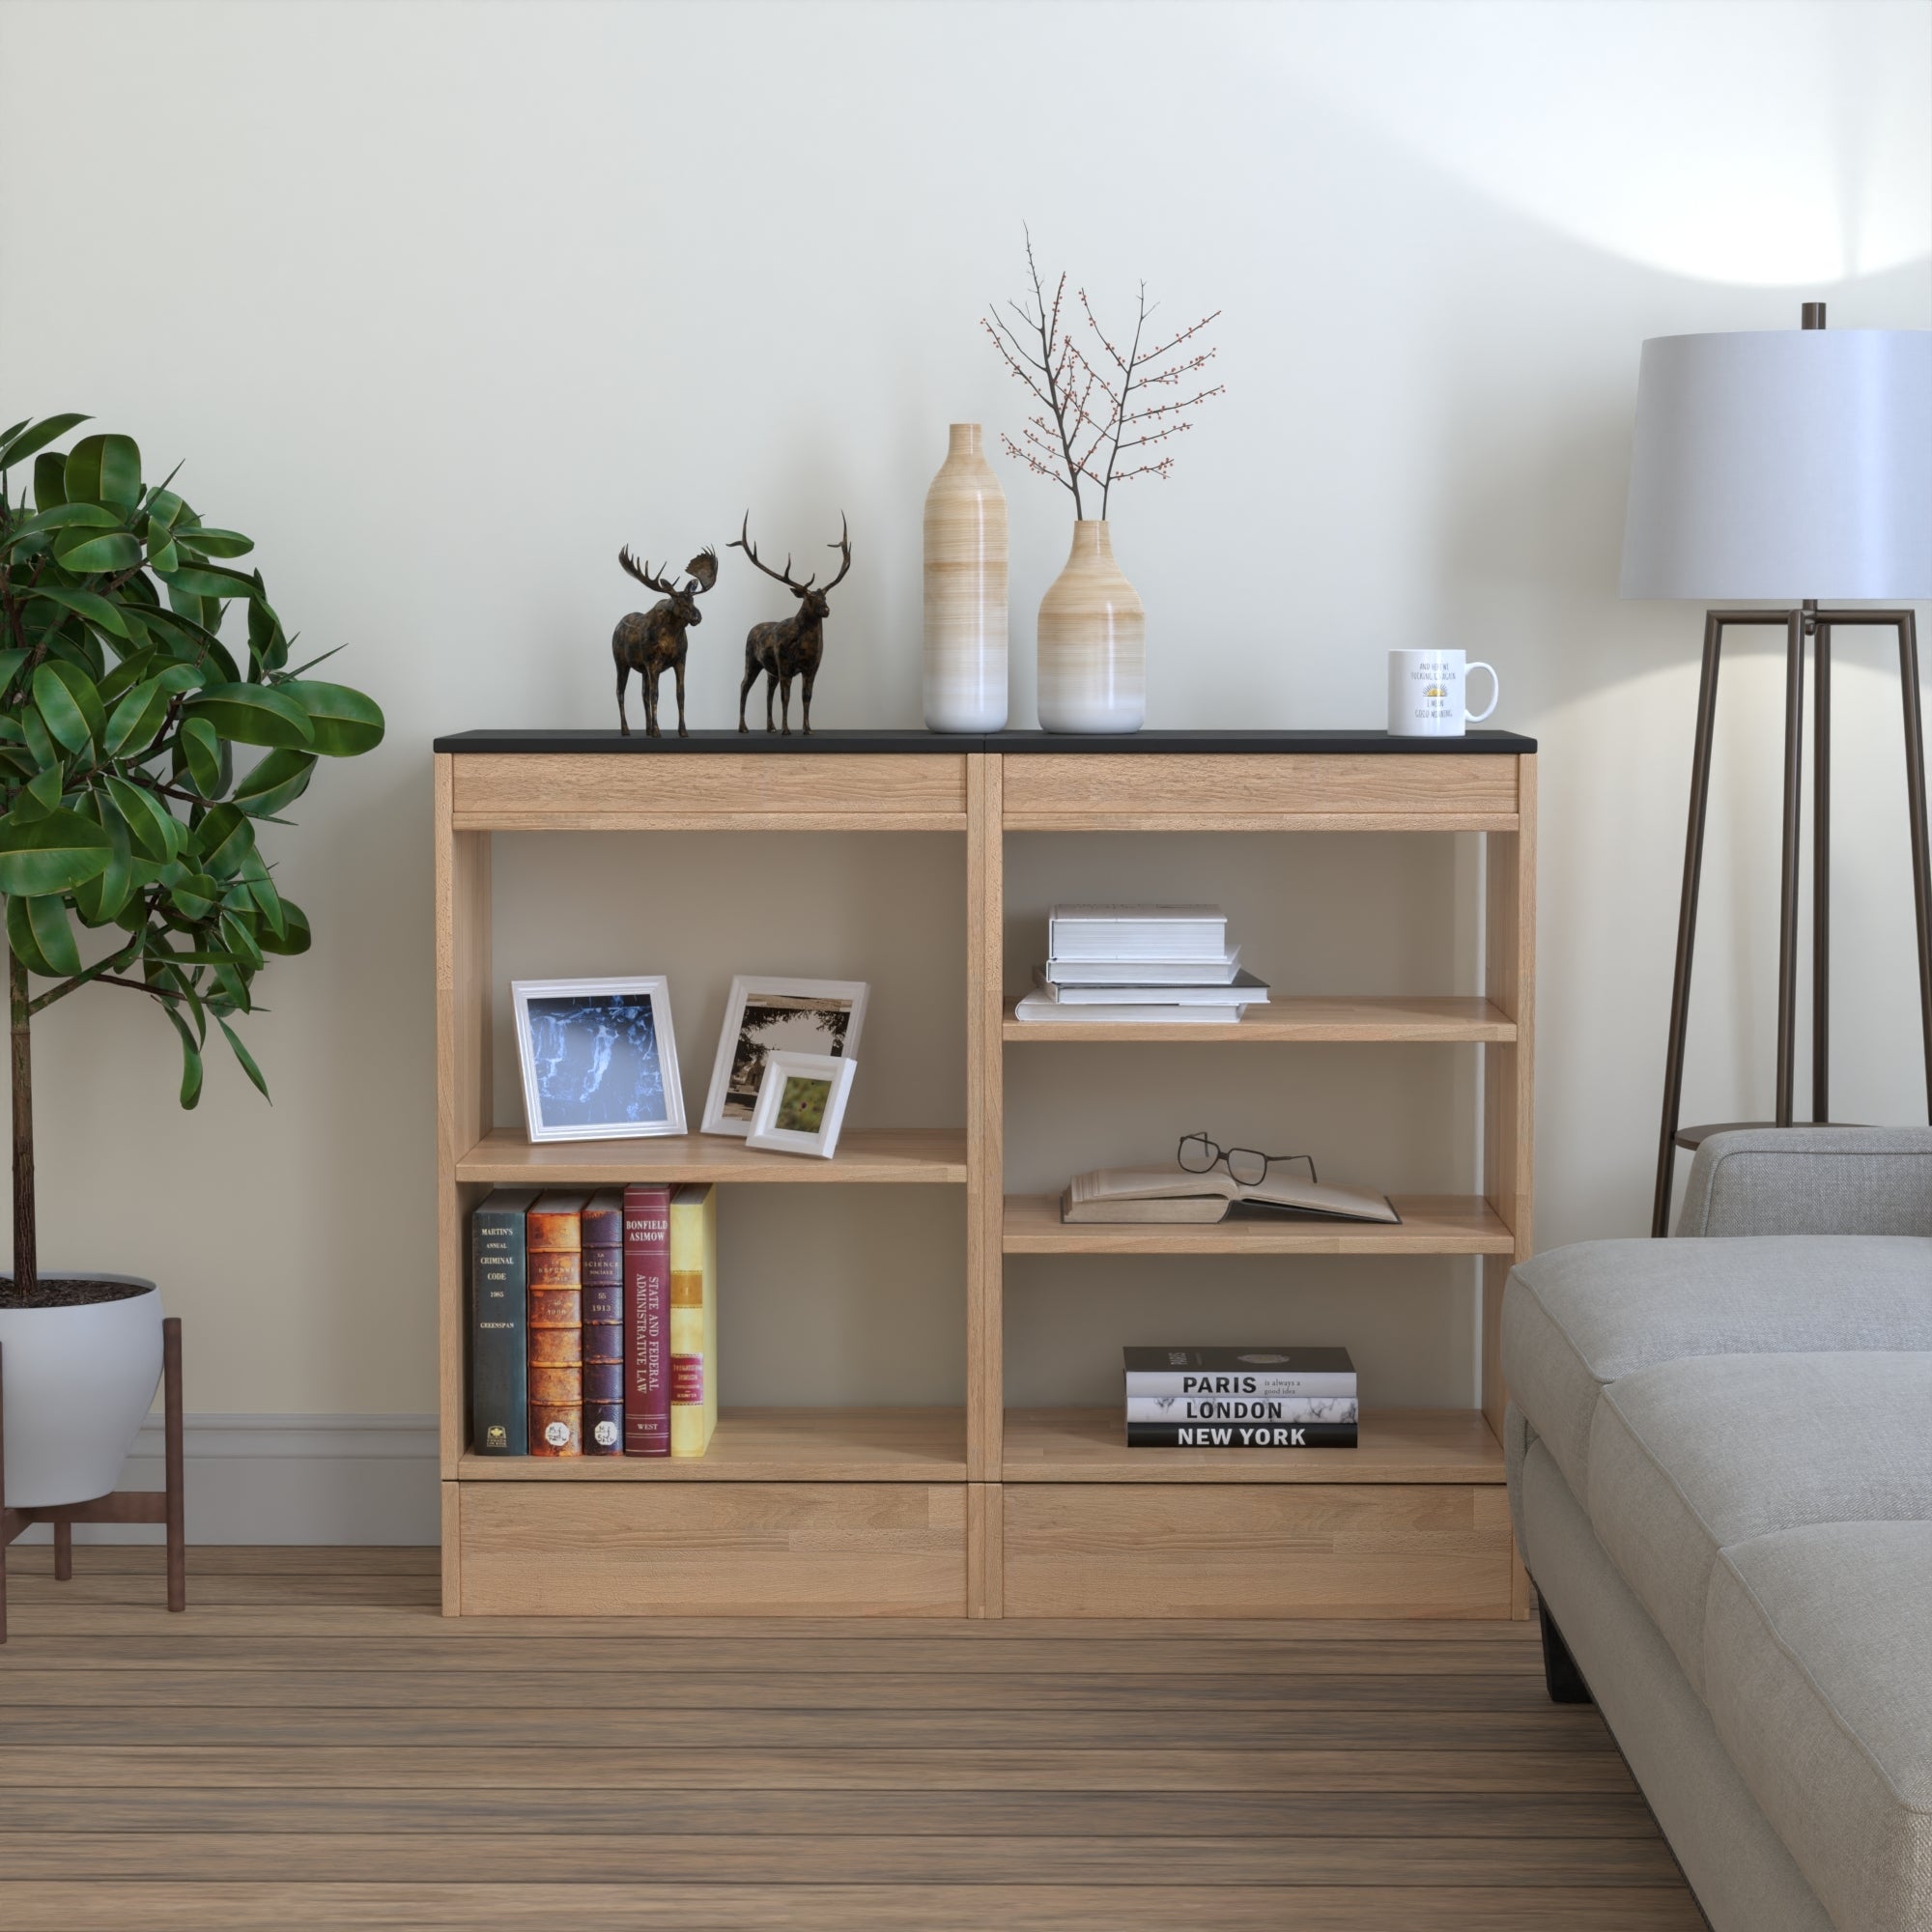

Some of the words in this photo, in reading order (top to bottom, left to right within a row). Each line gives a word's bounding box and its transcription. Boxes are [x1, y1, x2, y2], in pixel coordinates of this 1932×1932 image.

[1431, 709, 1453, 718] MONING
[481, 1228, 513, 1236] MARTIN'S
[626, 1220, 668, 1231] BONFIELD
[629, 1232, 665, 1242] ASIMOW
[487, 1272, 507, 1281] CODE
[648, 1275, 658, 1311] STATE
[636, 1273, 646, 1363] ADMINISTRATIVE
[648, 1314, 658, 1339] AND
[648, 1341, 658, 1392] FEDERAL
[636, 1365, 646, 1394] LAW
[1183, 1377, 1257, 1393] PARIS
[1271, 1378, 1294, 1388] always
[1186, 1402, 1282, 1419] LONDON
[1178, 1428, 1232, 1445] NEW
[1239, 1428, 1306, 1445] YORK
